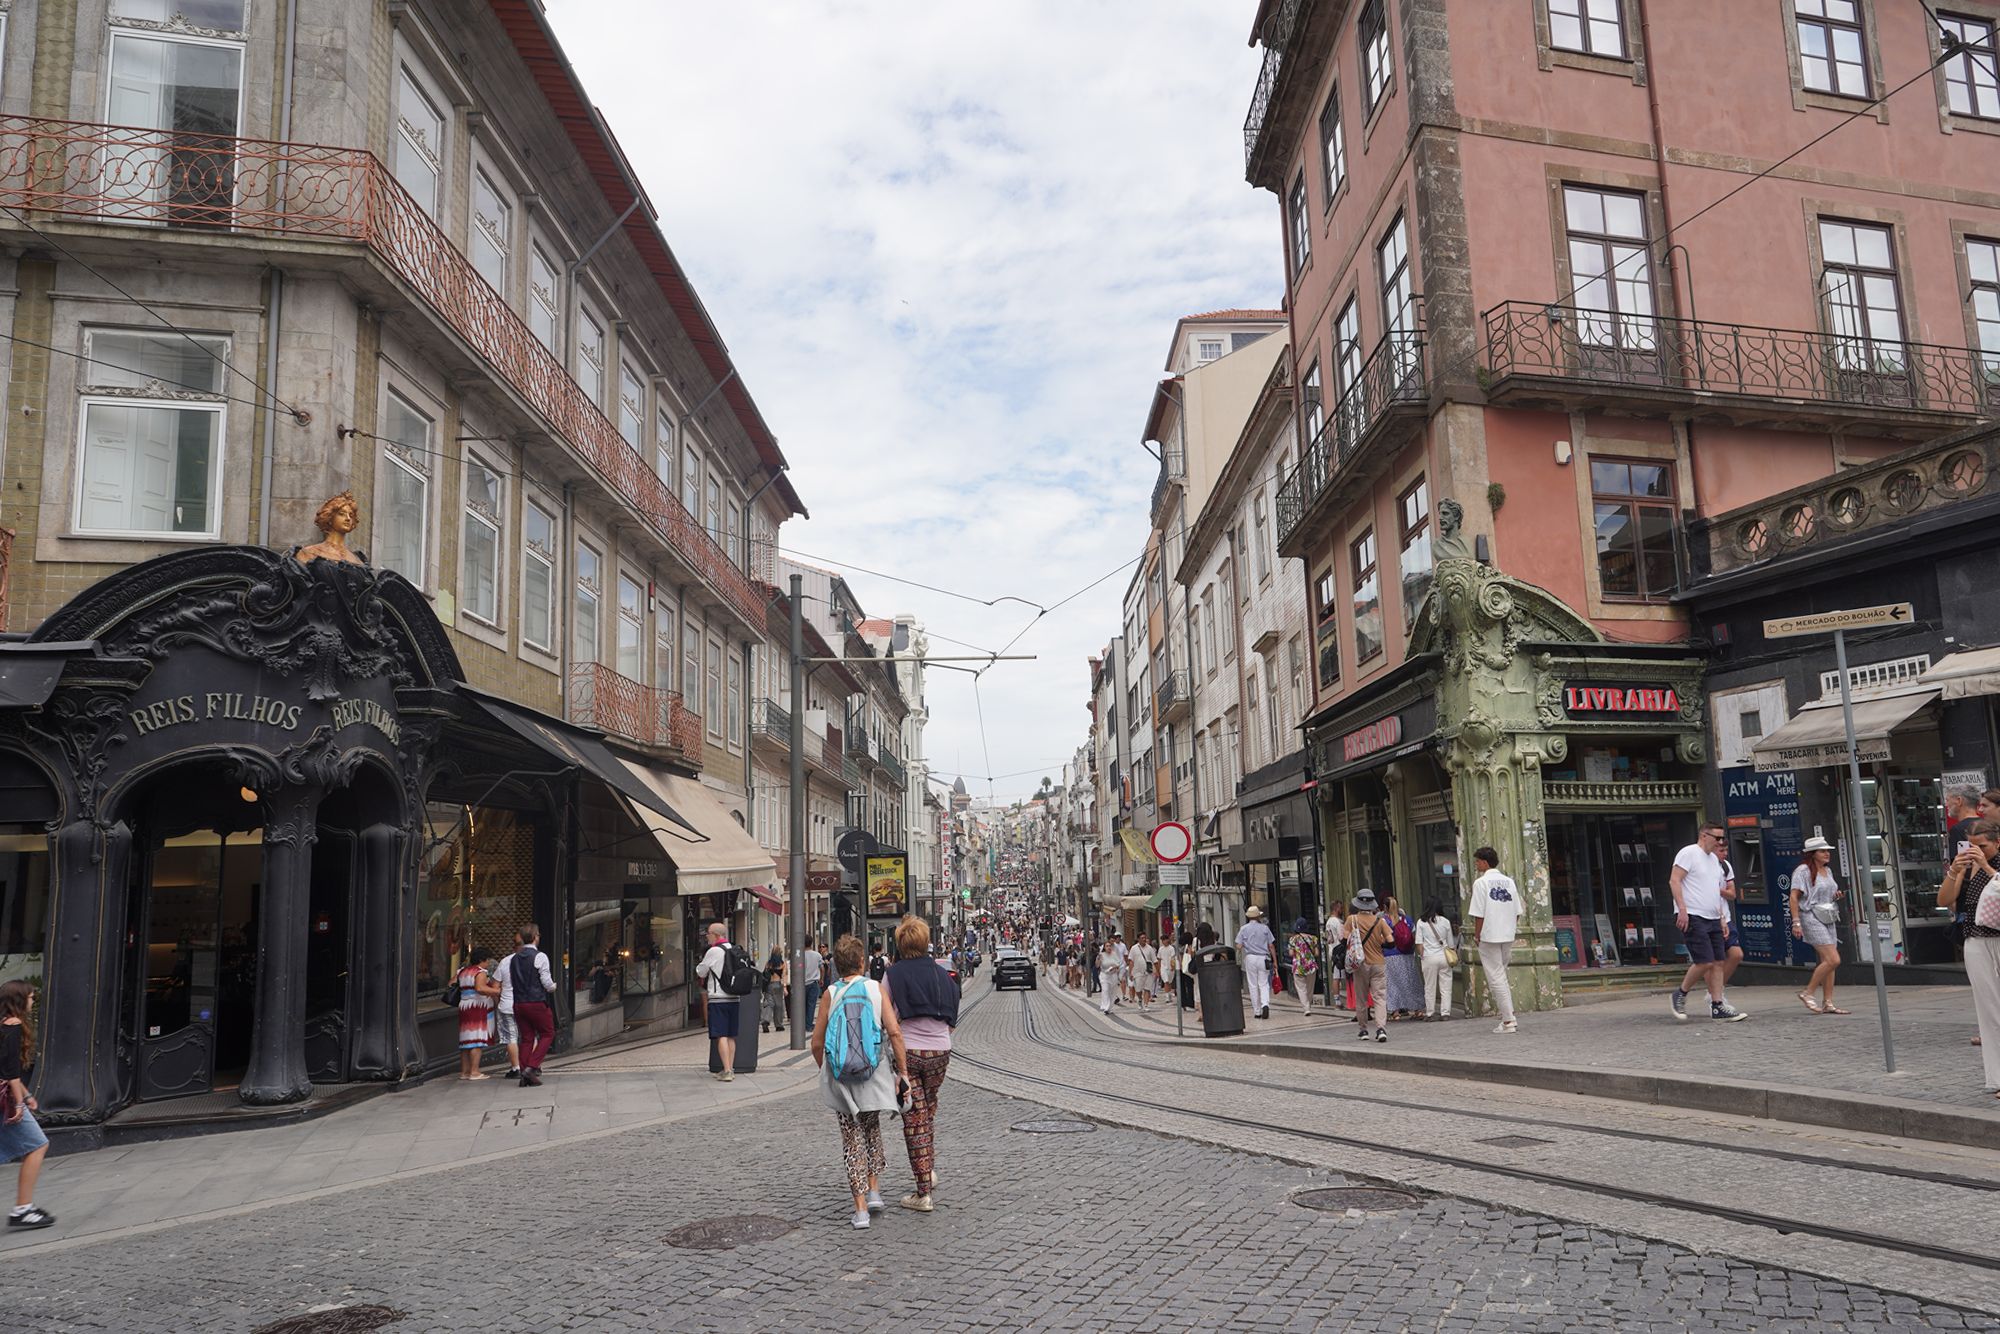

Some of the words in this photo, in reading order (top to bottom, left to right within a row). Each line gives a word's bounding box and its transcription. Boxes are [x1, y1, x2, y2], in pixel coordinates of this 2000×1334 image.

[1796, 617, 1836, 627] MERCADO
[1838, 614, 1850, 622] DO
[1852, 610, 1886, 620] BOLHÃO
[1565, 687, 1681, 711] LIVRARIA
[206, 693, 302, 730] FILHOS
[365, 699, 401, 746] FILHOS
[1343, 716, 1399, 762] BERTRAND
[1778, 747, 1820, 760] TABACARIA
[1824, 744, 1861, 756] BATALA
[1766, 773, 1796, 789] ATM
[1944, 773, 1982, 785] TABACARIA
[1729, 781, 1759, 797] ATM
[1776, 786, 1797, 796] HERE
[942, 811, 951, 889] PERFECT
